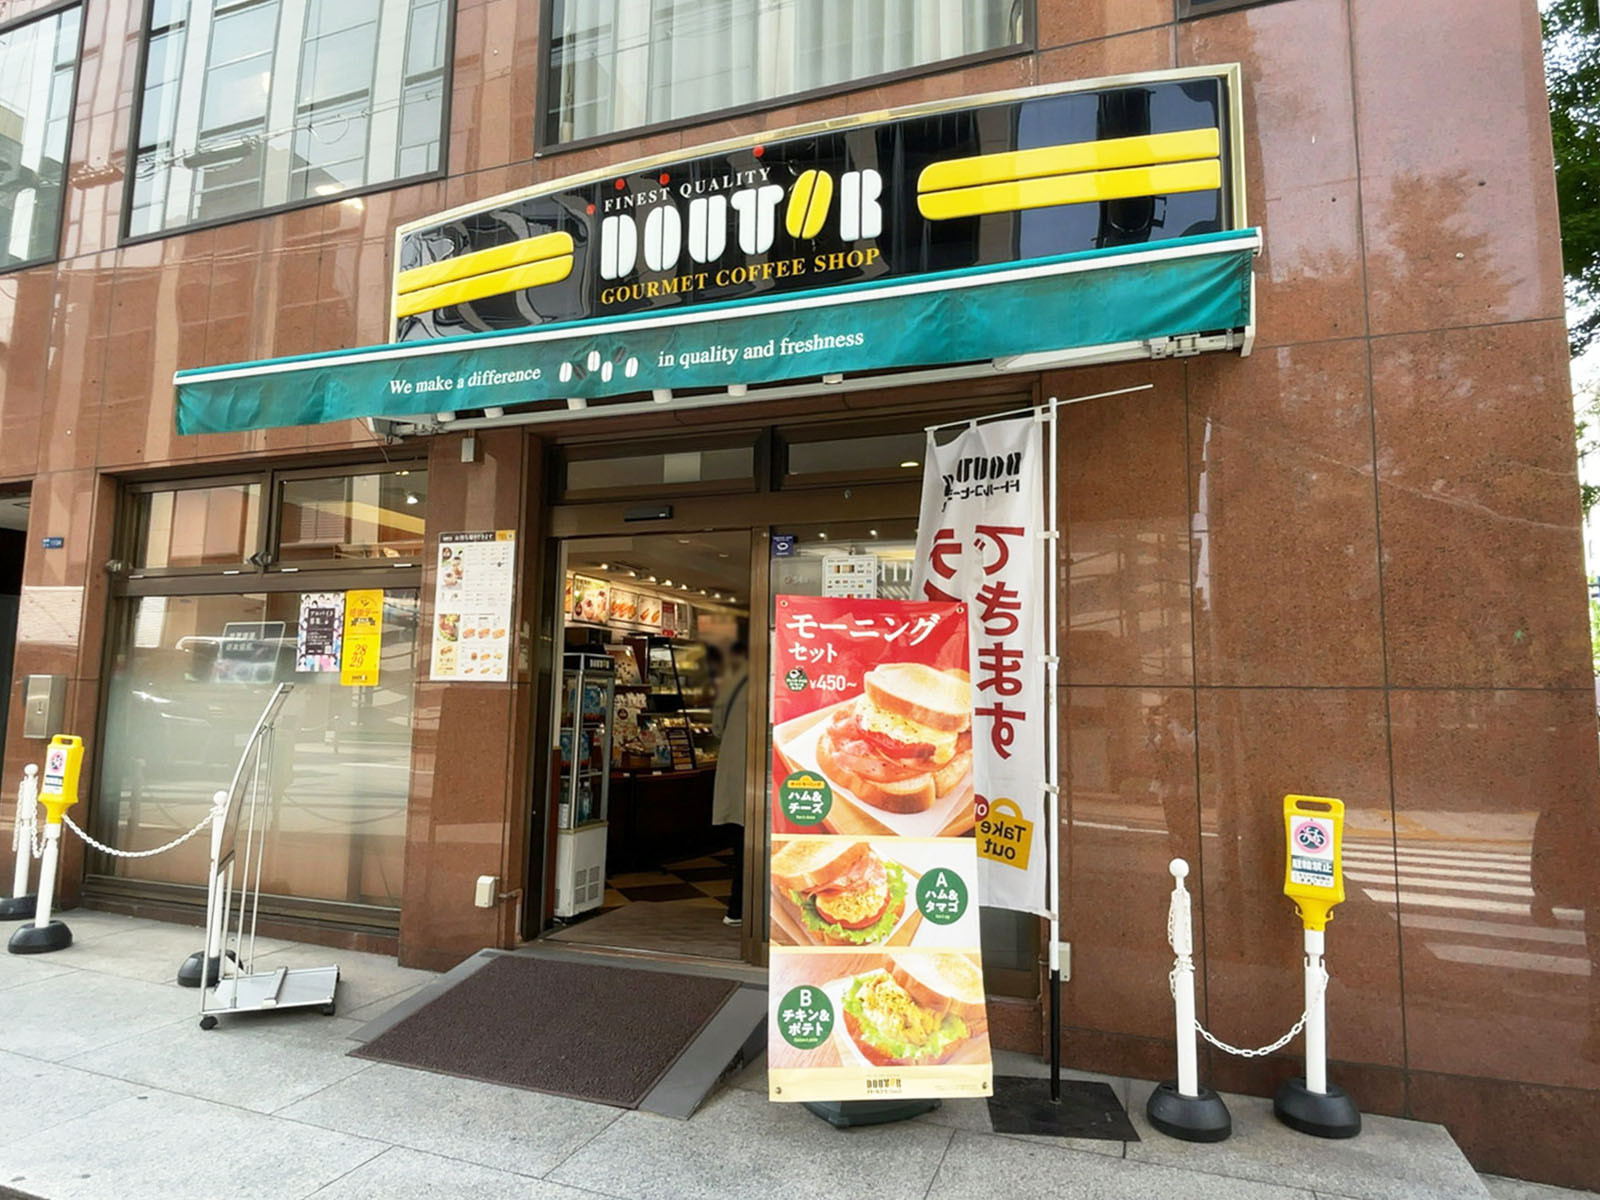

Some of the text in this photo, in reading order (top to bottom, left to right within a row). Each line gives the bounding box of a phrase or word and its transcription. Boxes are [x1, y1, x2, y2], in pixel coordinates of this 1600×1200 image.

[603, 167, 772, 212] FINEST QUALITY
[600, 169, 883, 281] DOUTOR
[601, 247, 880, 305] GOURMET COFFEE SHOP
[390, 332, 864, 394] We make a difference in quality and freshness
[786, 613, 941, 646] モーニング
[788, 643, 838, 663] セット
[788, 791, 823, 802] ハム&
[788, 801, 824, 814] チーズ
[936, 872, 948, 887] A
[925, 889, 958, 900] ハム&
[925, 900, 959, 912] タマゴ
[800, 989, 812, 1007] B
[782, 1008, 830, 1022] チキン&
[788, 1022, 823, 1036] ポテト
